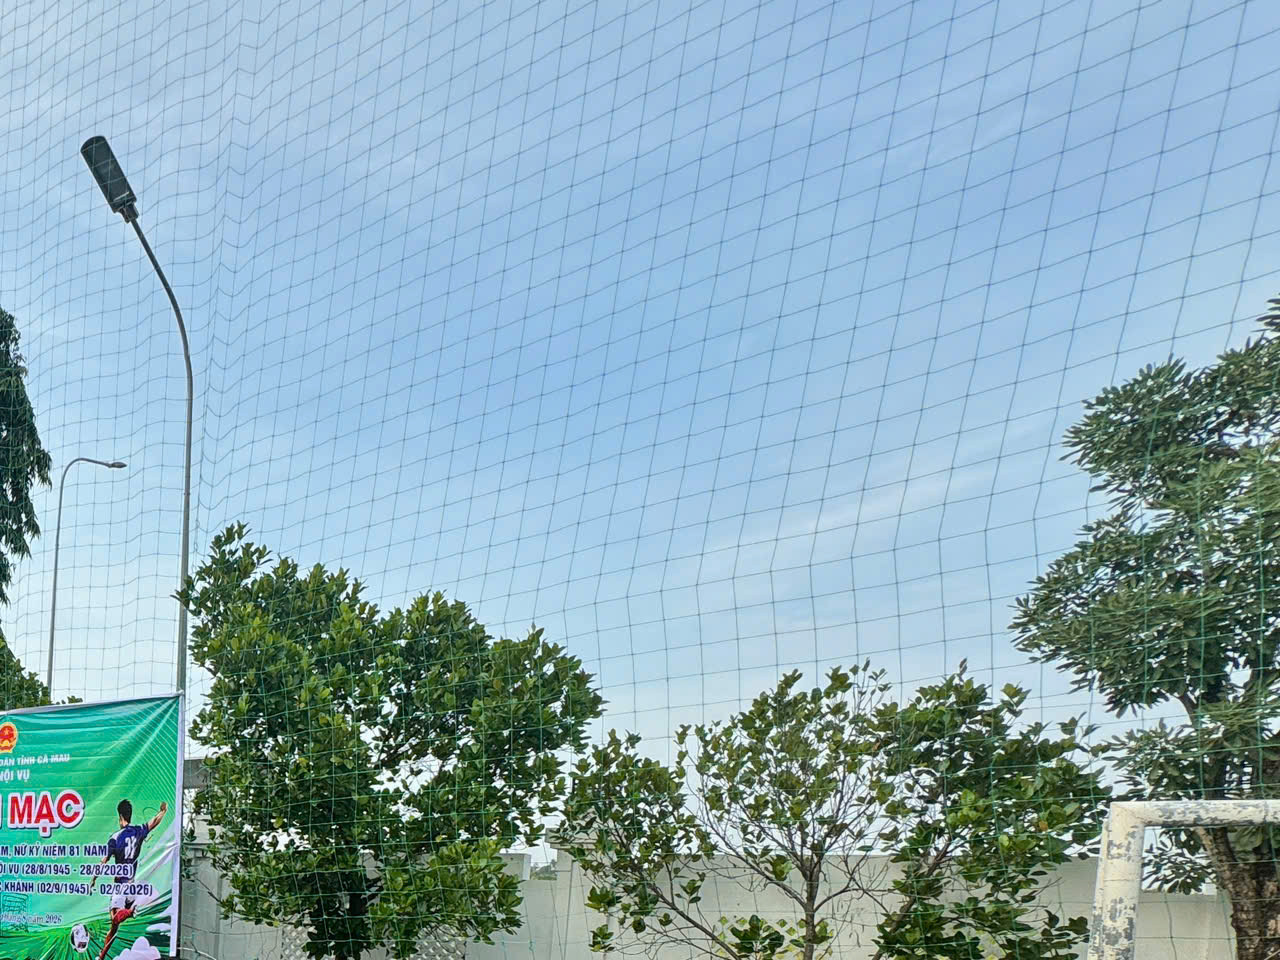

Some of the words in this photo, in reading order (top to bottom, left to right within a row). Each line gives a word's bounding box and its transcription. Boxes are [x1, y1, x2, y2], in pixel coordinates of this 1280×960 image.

[16, 769, 30, 782] VỤ
[9, 792, 81, 834] MẠC
[14, 843, 27, 857] NỮ
[42, 844, 66, 859] NIỆM
[69, 845, 80, 857] 81
[83, 843, 108, 857] NĂM
[8, 863, 20, 877] VỤ
[22, 863, 70, 876] (28/8/1945
[79, 864, 133, 877] 28/8/2026)
[4, 879, 34, 893] KHÁNH
[100, 883, 153, 896] 02/9/2026)
